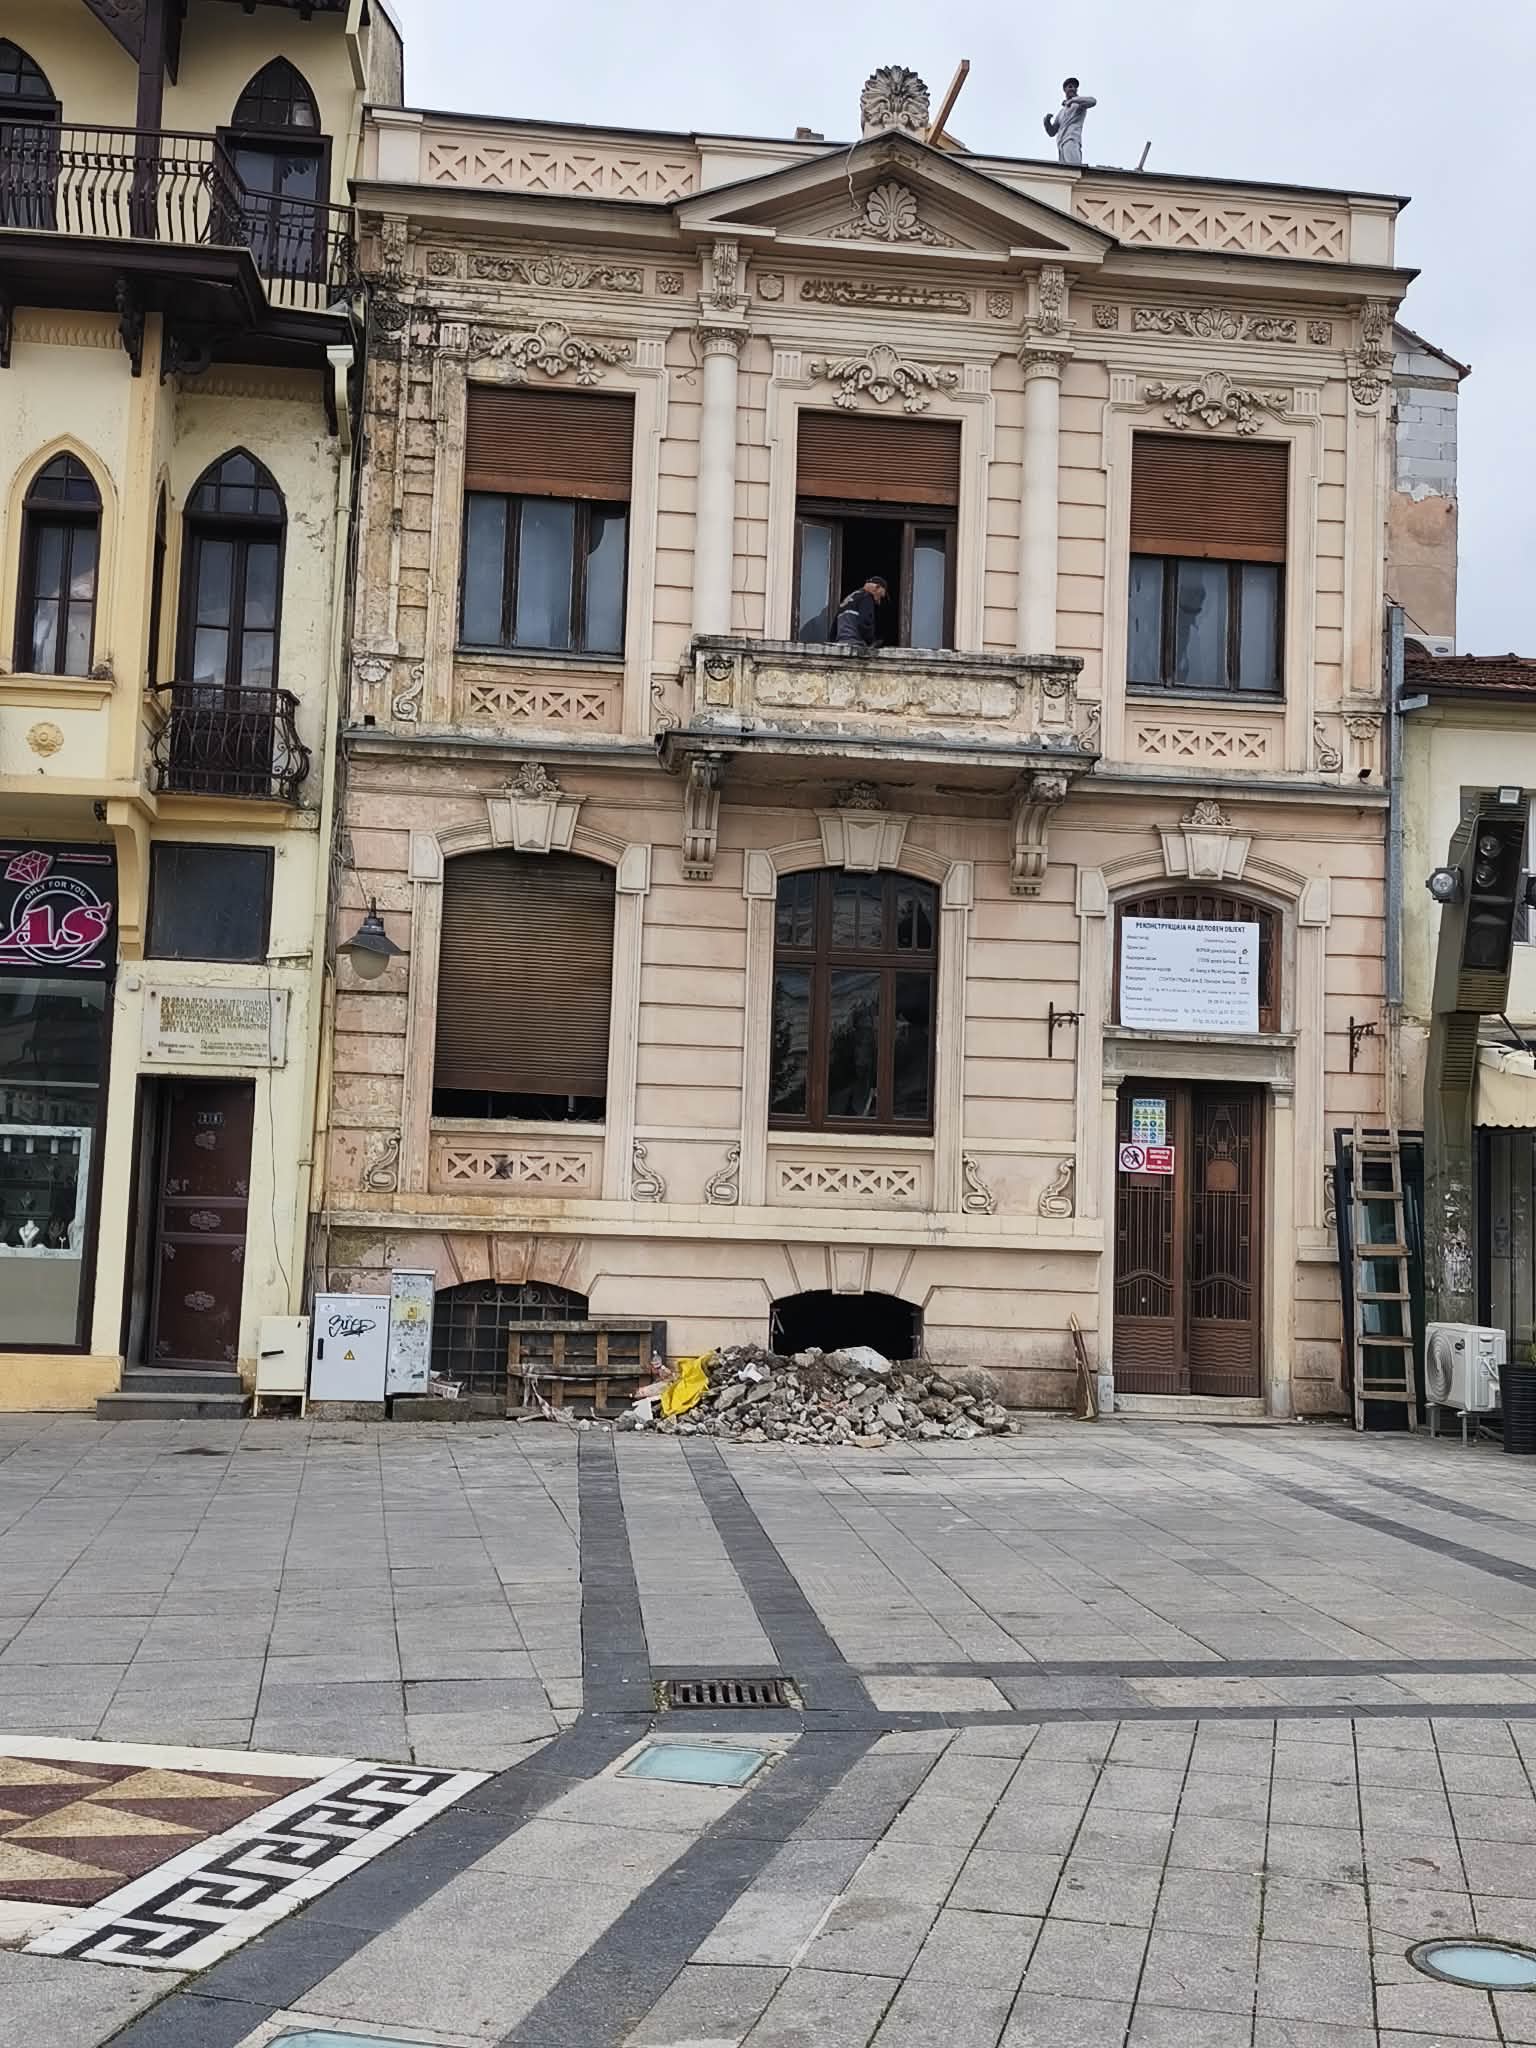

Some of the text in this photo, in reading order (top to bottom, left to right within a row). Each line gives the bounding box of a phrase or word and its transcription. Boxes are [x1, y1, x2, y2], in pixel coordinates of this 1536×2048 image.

[24, 881, 88, 901] ONLY FOR YOU
